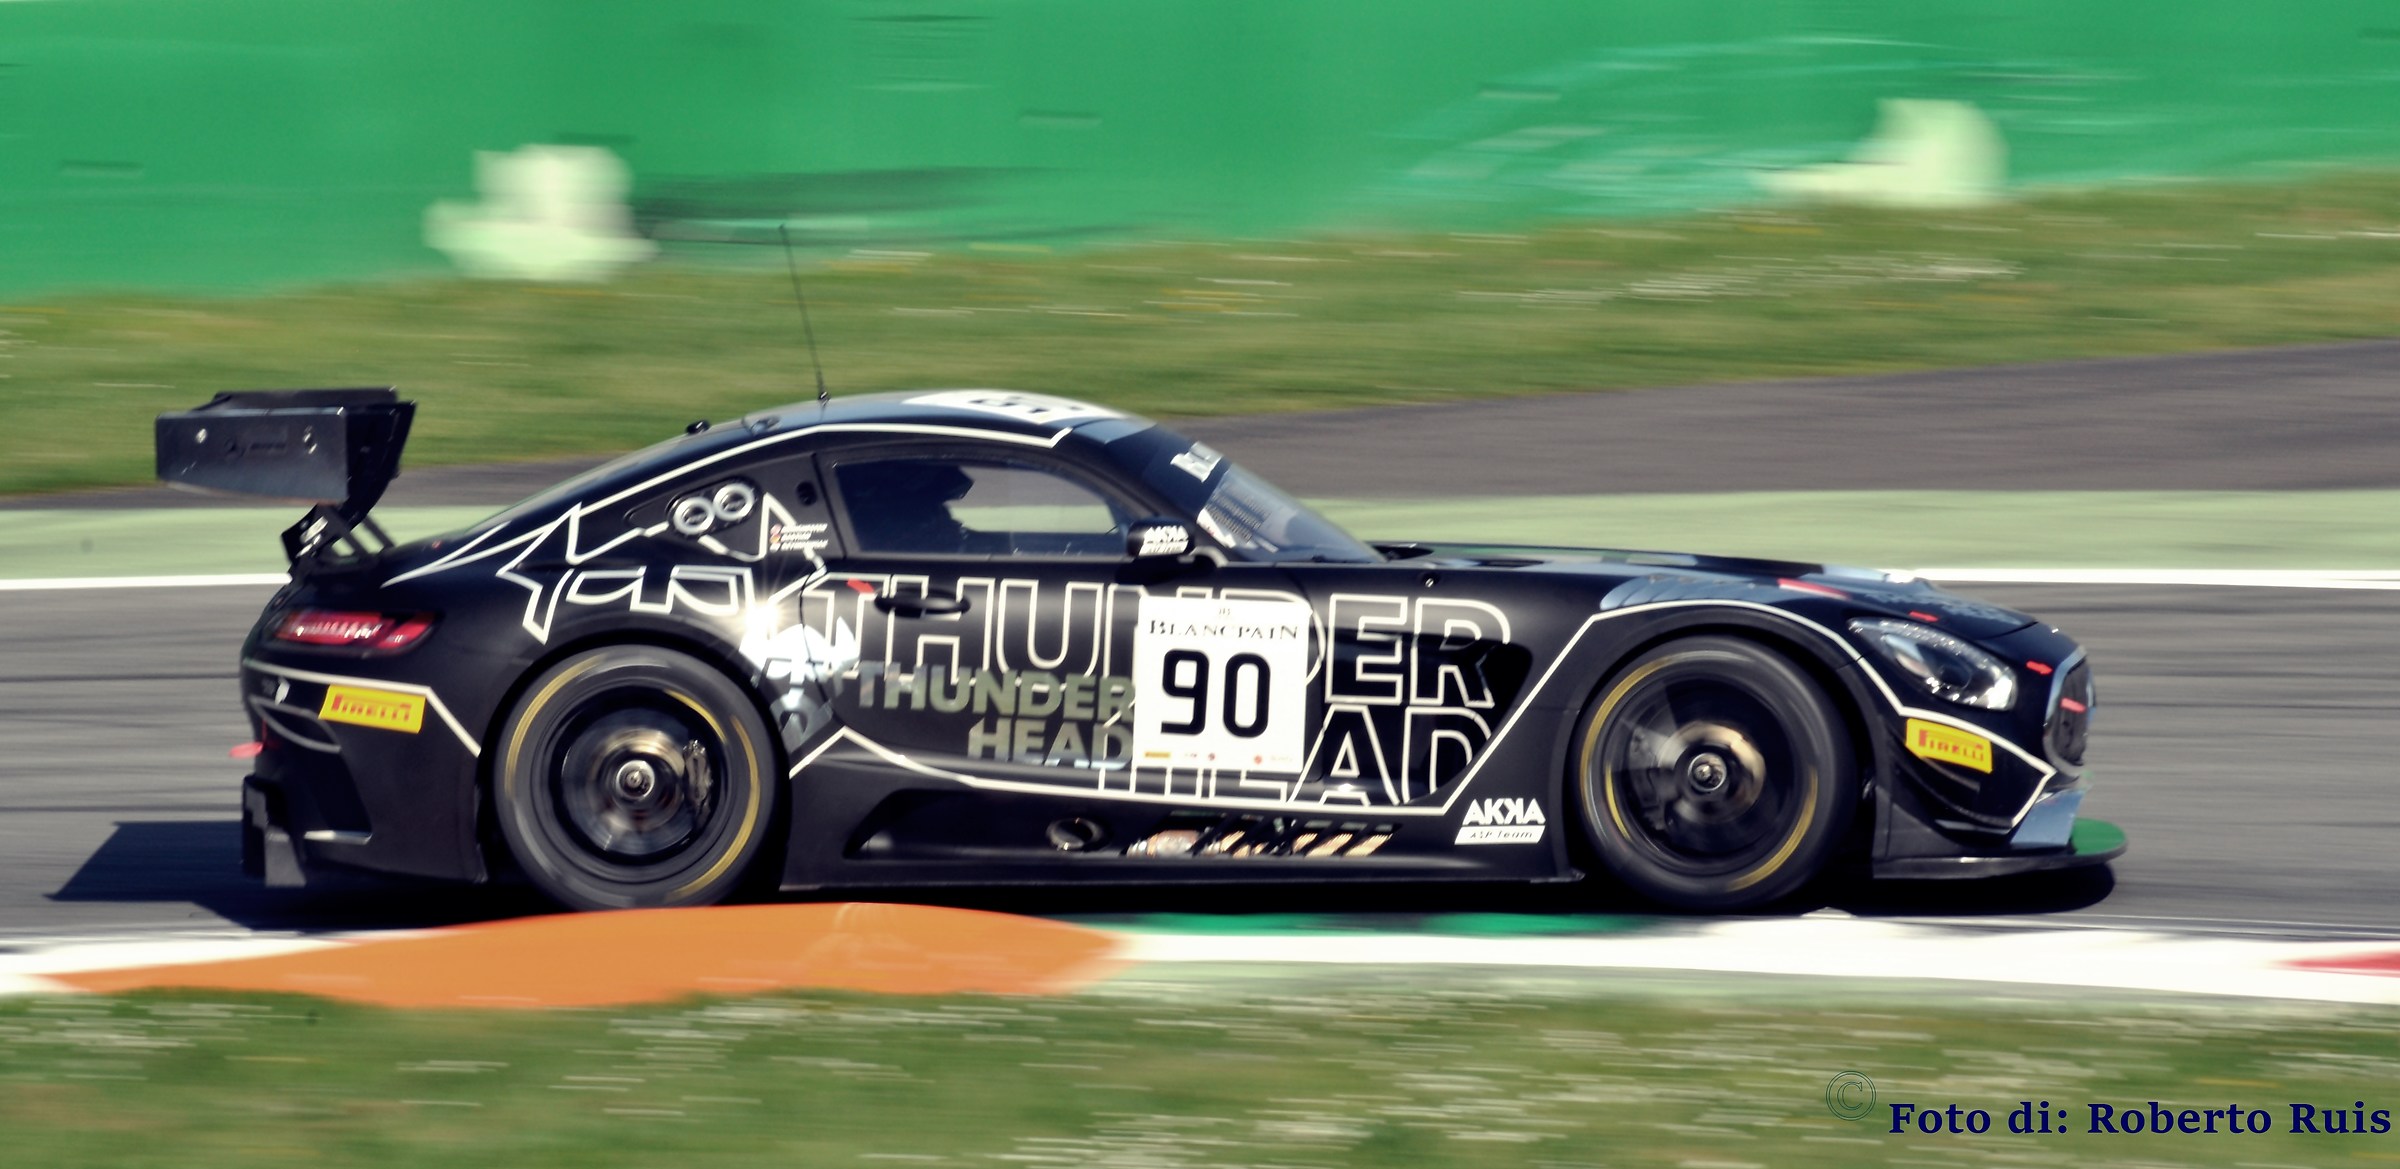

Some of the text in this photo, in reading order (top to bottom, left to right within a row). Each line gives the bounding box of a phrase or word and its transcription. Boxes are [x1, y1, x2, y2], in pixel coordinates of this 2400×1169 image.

[1150, 620, 1298, 640] BLANCPAIN
[858, 659, 1135, 722] THUNDER
[1160, 648, 1271, 739] 90
[331, 693, 412, 722] PIRELLI
[967, 715, 1134, 770] HEAD
[1918, 729, 1984, 762] PIRELLI
[1462, 797, 1546, 825] AKKA
